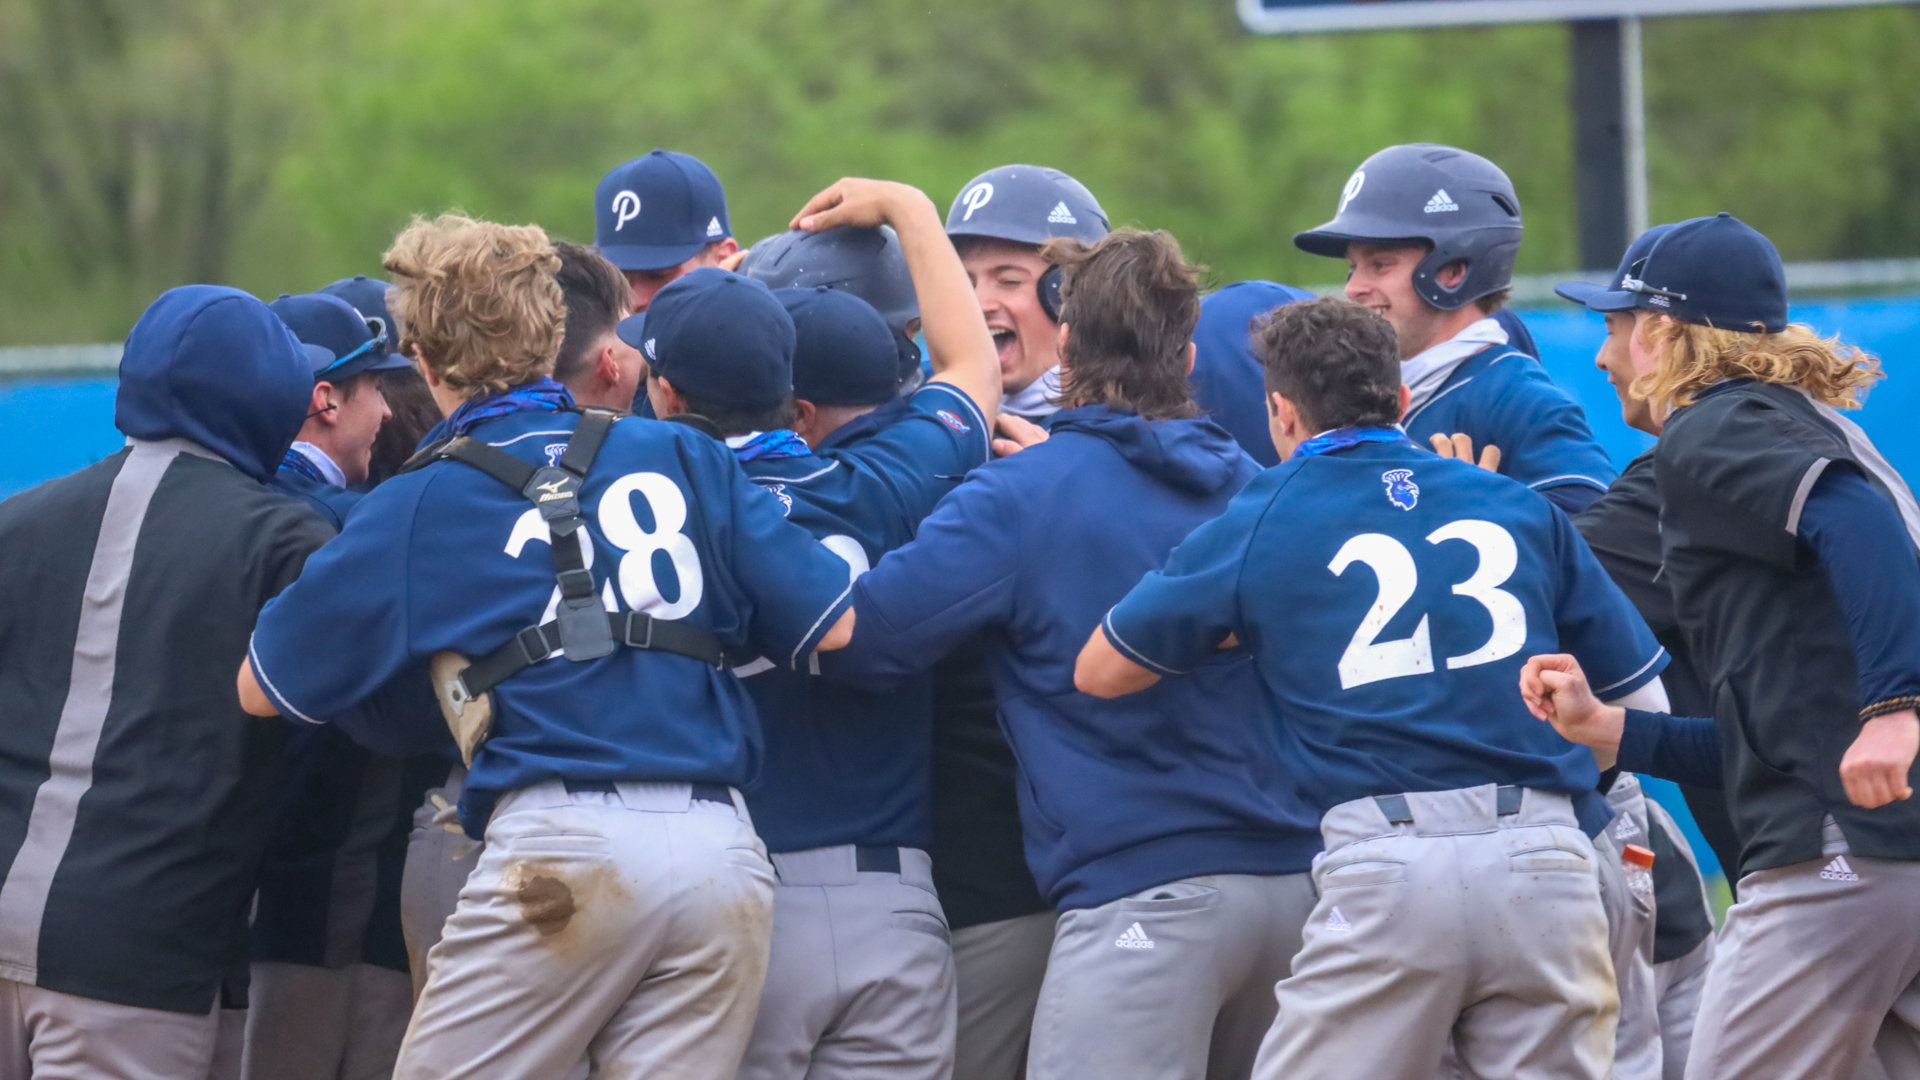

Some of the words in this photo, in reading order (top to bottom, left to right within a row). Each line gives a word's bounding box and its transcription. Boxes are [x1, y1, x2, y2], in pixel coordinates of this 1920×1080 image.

[962, 182, 994, 221] P
[1340, 170, 1366, 213] P
[611, 189, 641, 231] P
[1047, 214, 1077, 224] adidas
[1424, 202, 1459, 213] adidas
[1327, 519, 1527, 690] 23
[1820, 870, 1859, 881] adidas
[1115, 938, 1155, 948] adidas
